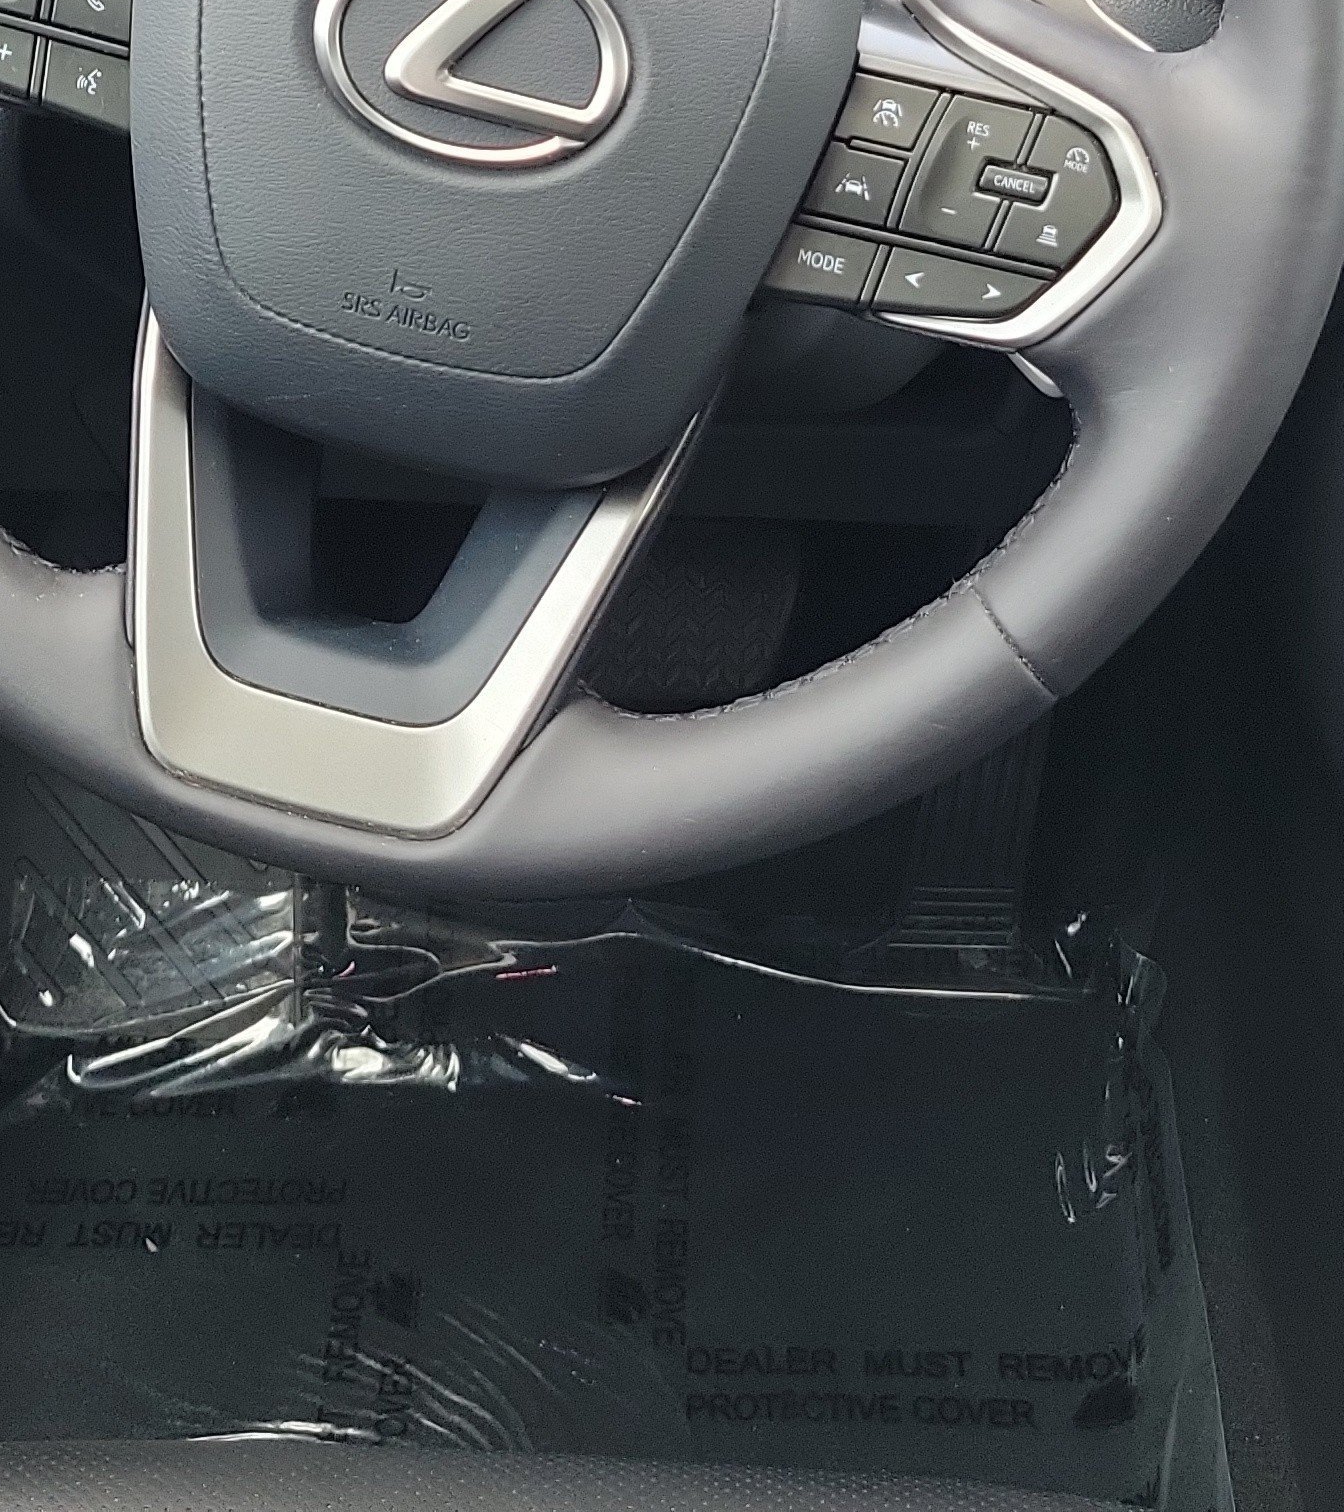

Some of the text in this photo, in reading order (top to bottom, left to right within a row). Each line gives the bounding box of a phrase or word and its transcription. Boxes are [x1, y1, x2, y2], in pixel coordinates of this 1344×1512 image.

[967, 120, 990, 138] RES
[1064, 160, 1089, 173] MODE
[993, 174, 1036, 194] CANCEL
[798, 248, 845, 275] MODE
[341, 291, 471, 342] SRS AIRBAG
[25, 1177, 348, 1206] PROTECTIVE COVER
[67, 1221, 172, 1251] MUST
[197, 1221, 342, 1249] DEALER
[685, 1346, 837, 1376] DEALER
[864, 1349, 971, 1378] MUST
[685, 1392, 1039, 1428] PROTECTIVE COVER
